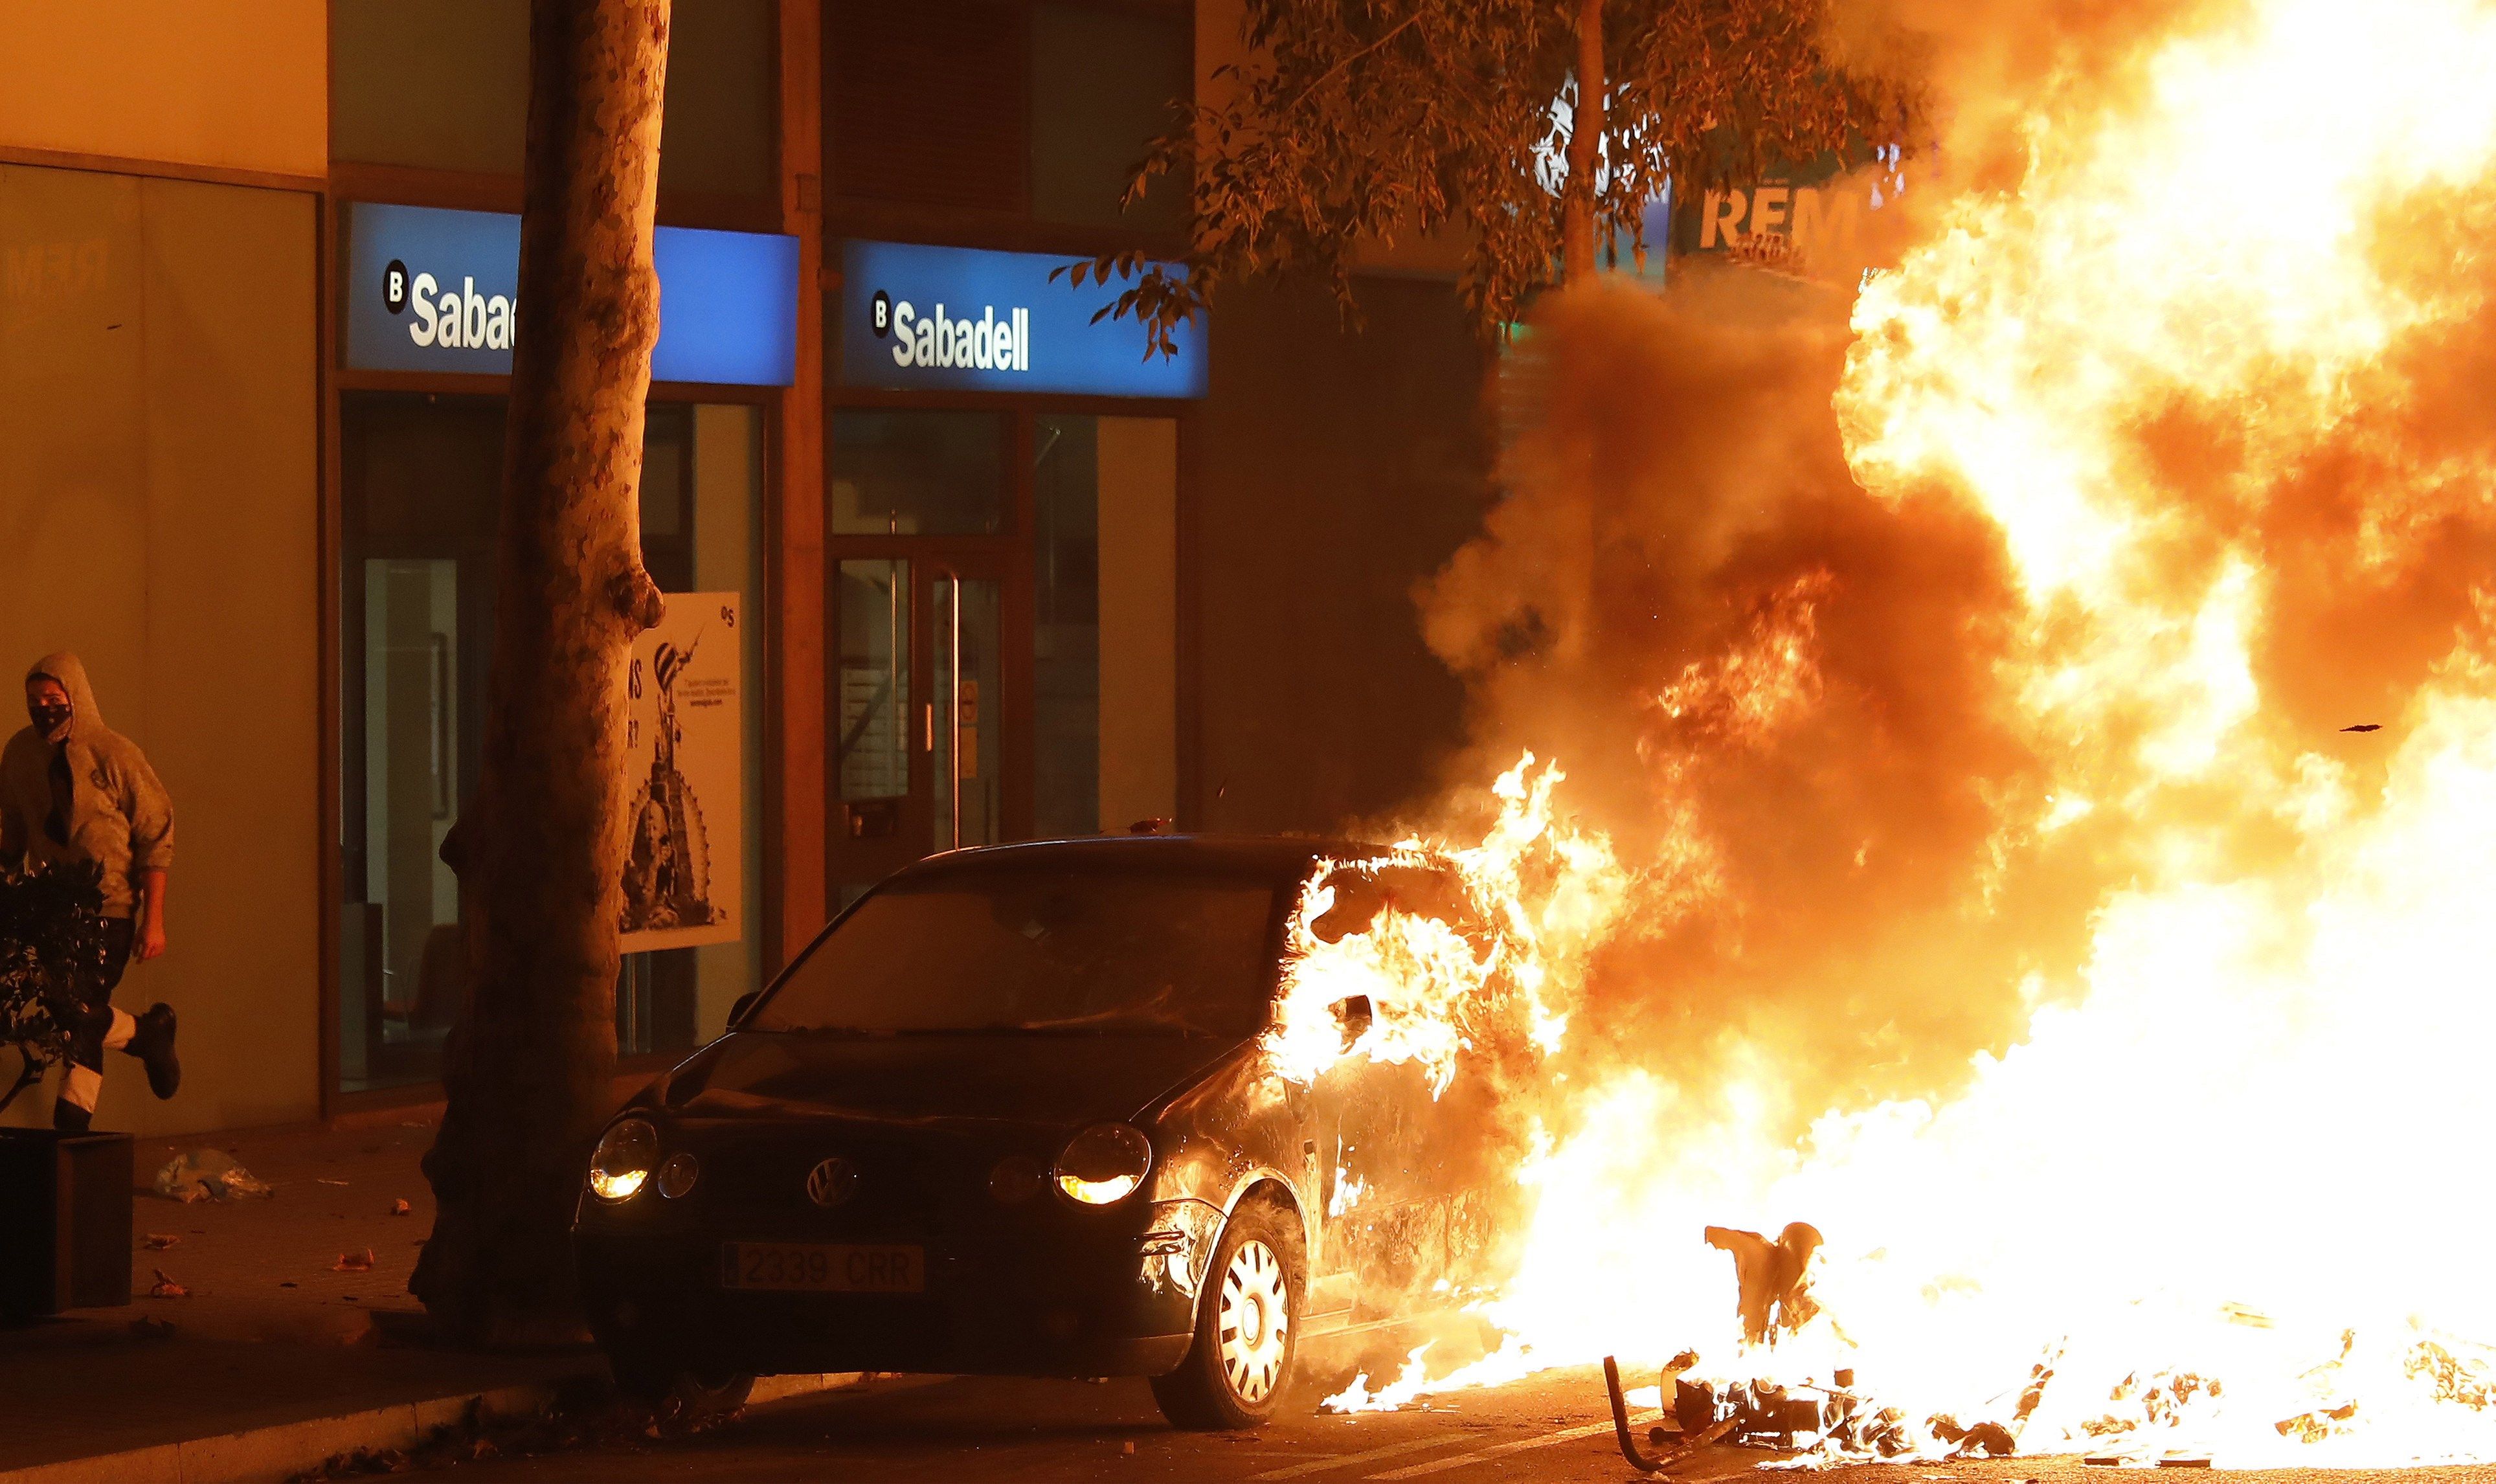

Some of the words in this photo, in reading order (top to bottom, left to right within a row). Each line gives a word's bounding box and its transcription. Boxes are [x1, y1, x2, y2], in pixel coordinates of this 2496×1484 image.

[892, 300, 1029, 372] Sabadell
[746, 1249, 828, 1284] 2339
[848, 1251, 910, 1286] CRR
